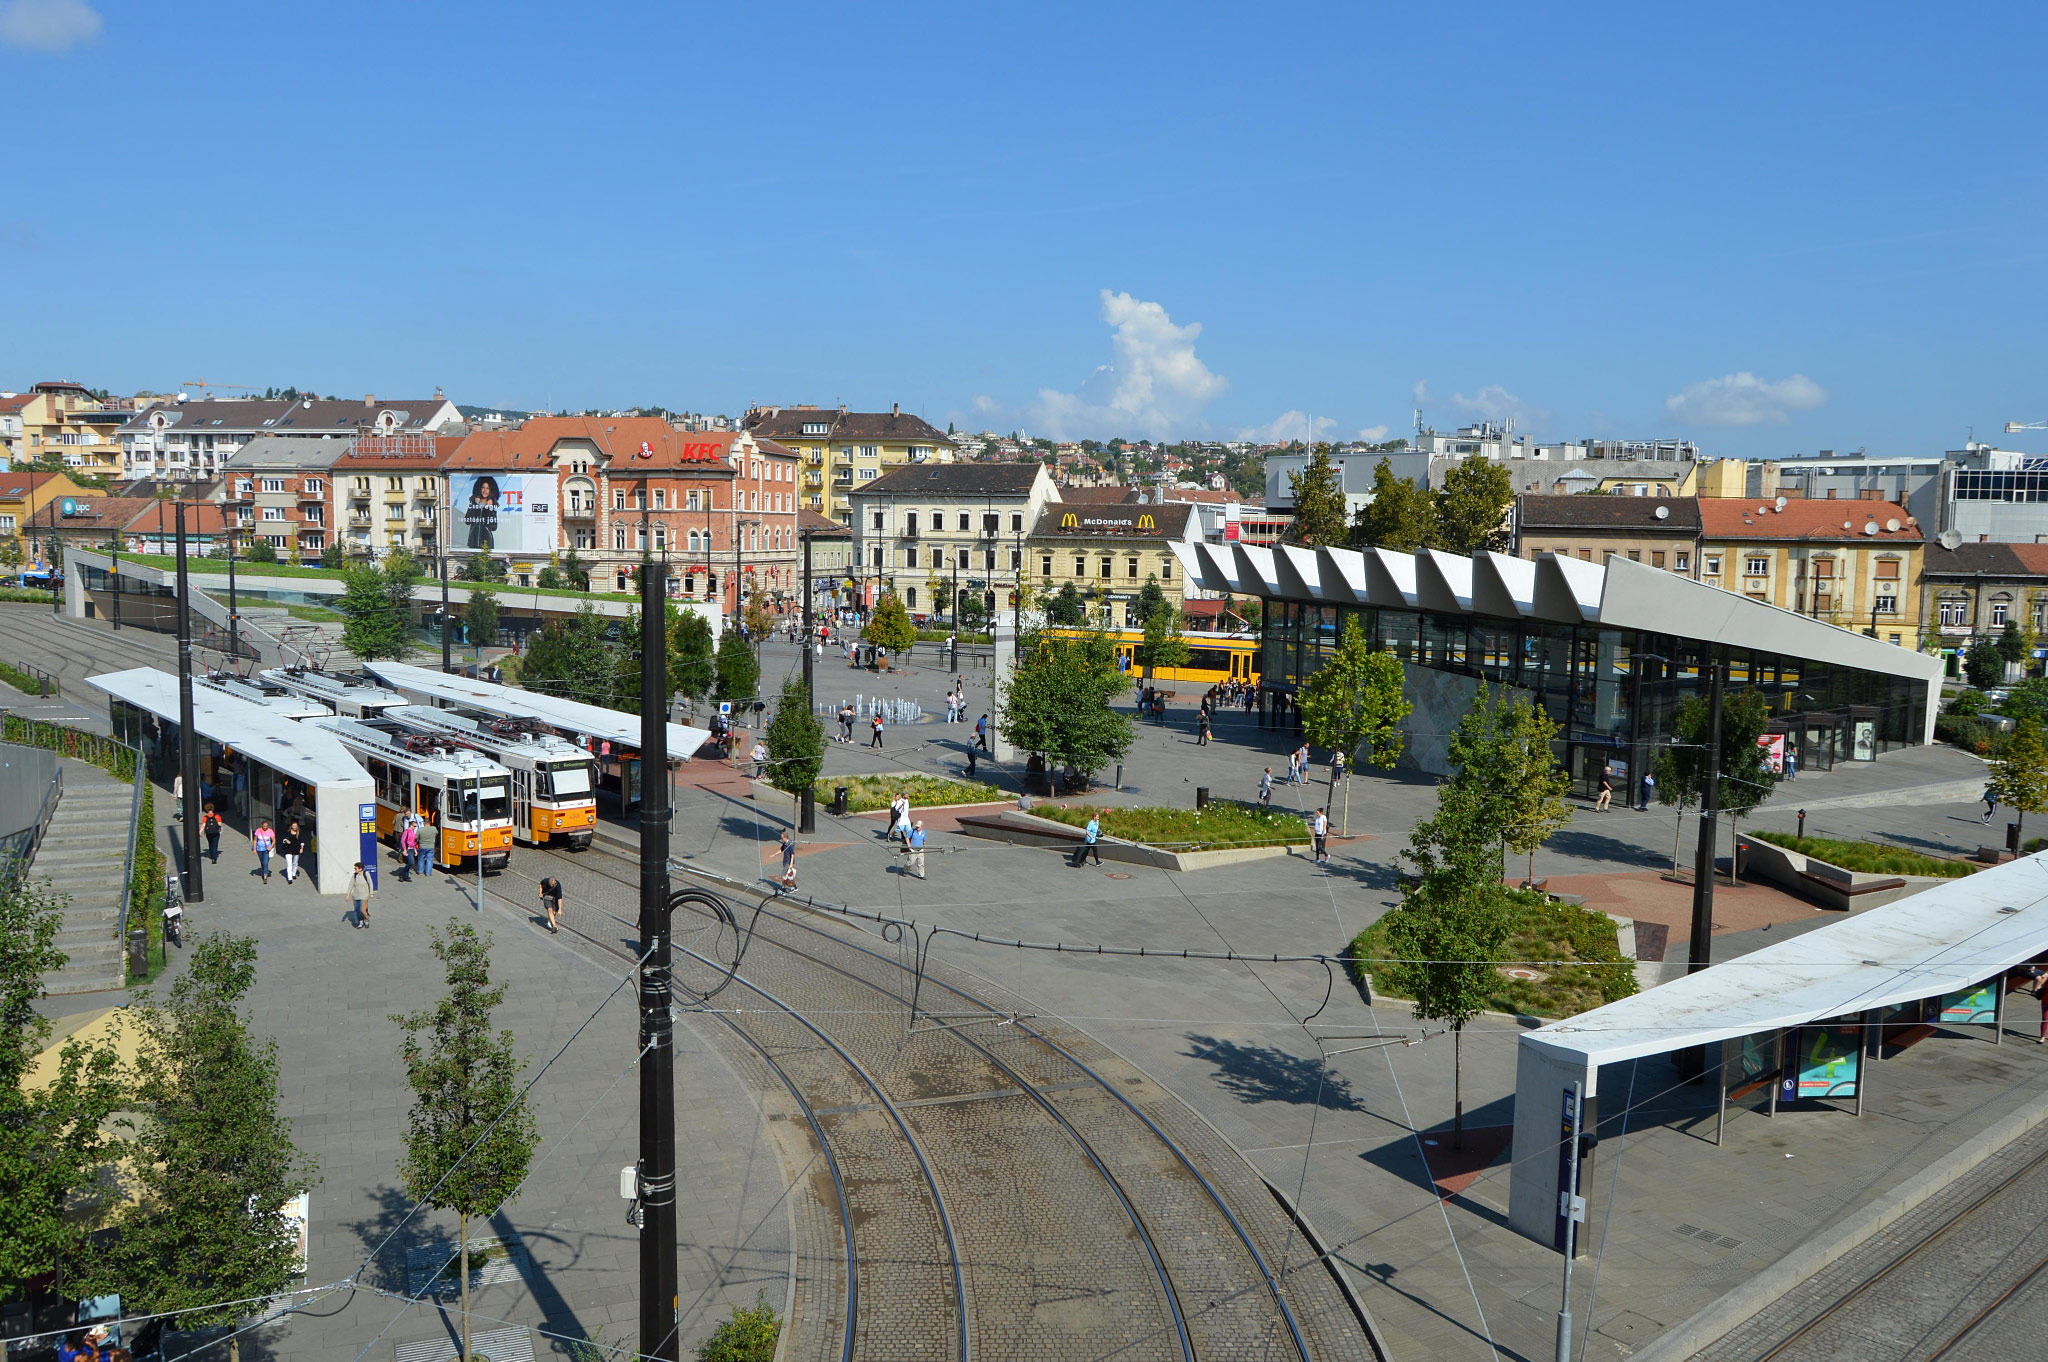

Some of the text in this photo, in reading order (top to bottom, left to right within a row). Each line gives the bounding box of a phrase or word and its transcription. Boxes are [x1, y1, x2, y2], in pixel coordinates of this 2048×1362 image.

[682, 443, 722, 460] KFC
[75, 505, 90, 513] upc
[532, 504, 547, 512] F&F
[1083, 518, 1133, 526] McDonald's
